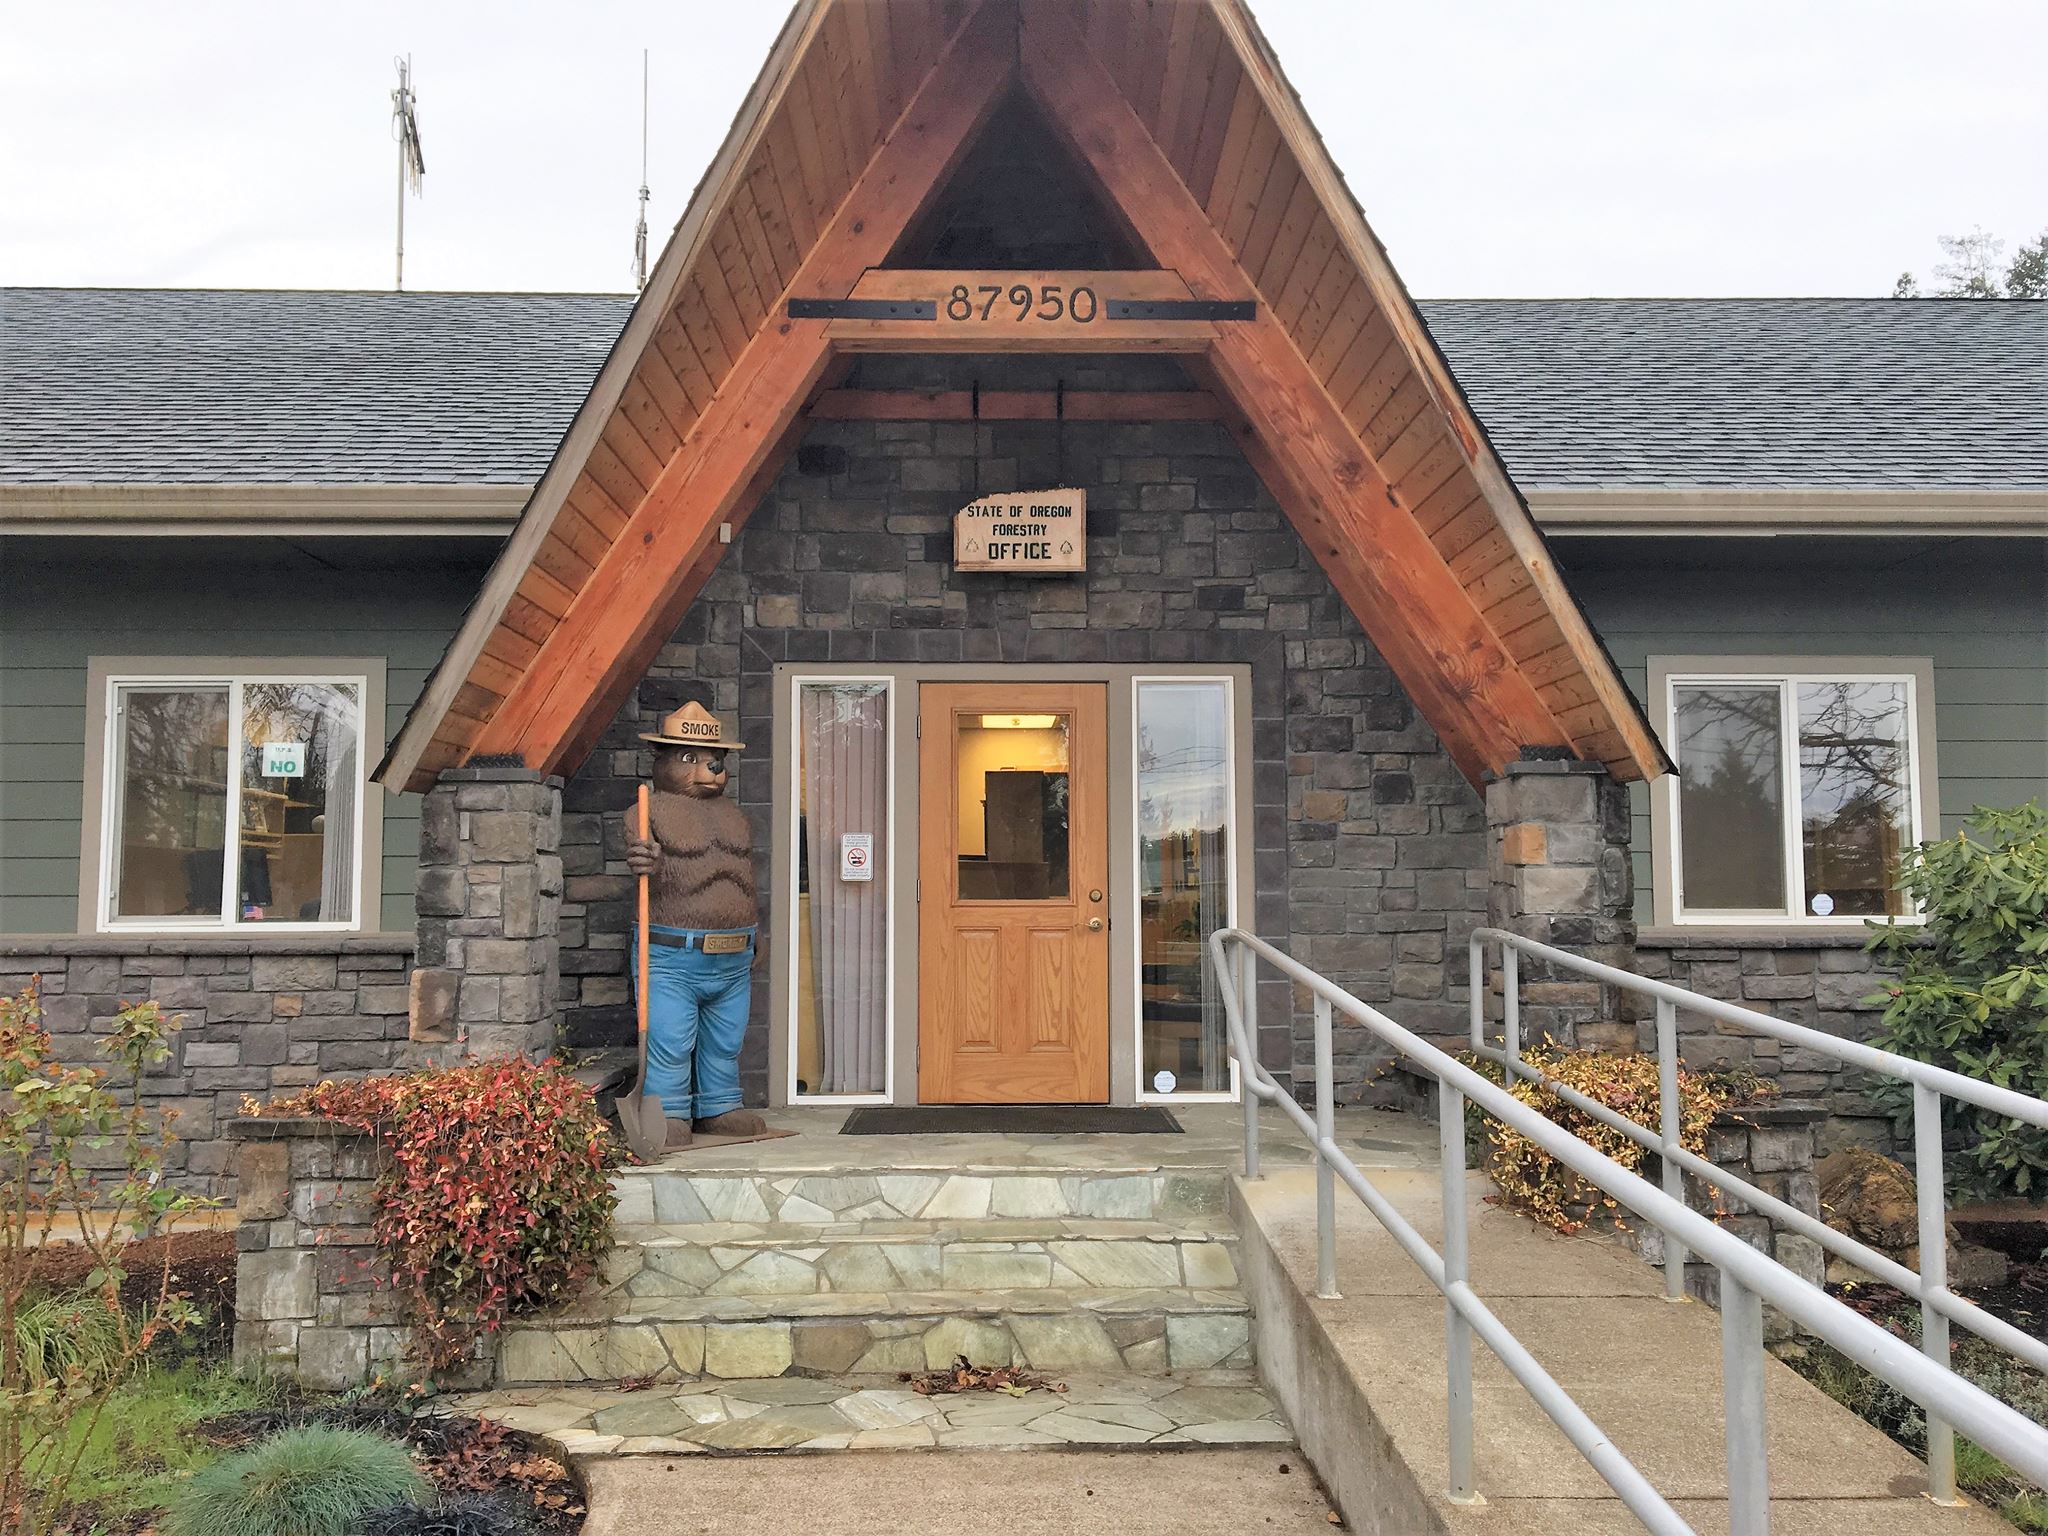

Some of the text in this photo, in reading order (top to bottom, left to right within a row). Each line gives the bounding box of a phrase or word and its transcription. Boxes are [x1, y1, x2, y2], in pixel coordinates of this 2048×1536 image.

[946, 284, 1097, 323] 87950
[967, 505, 1072, 518] STATE OF OREGON
[992, 524, 1047, 536] FORESTRY
[988, 542, 1052, 560] OFFICE
[681, 721, 720, 736] SMOKE
[270, 760, 296, 773] NO
